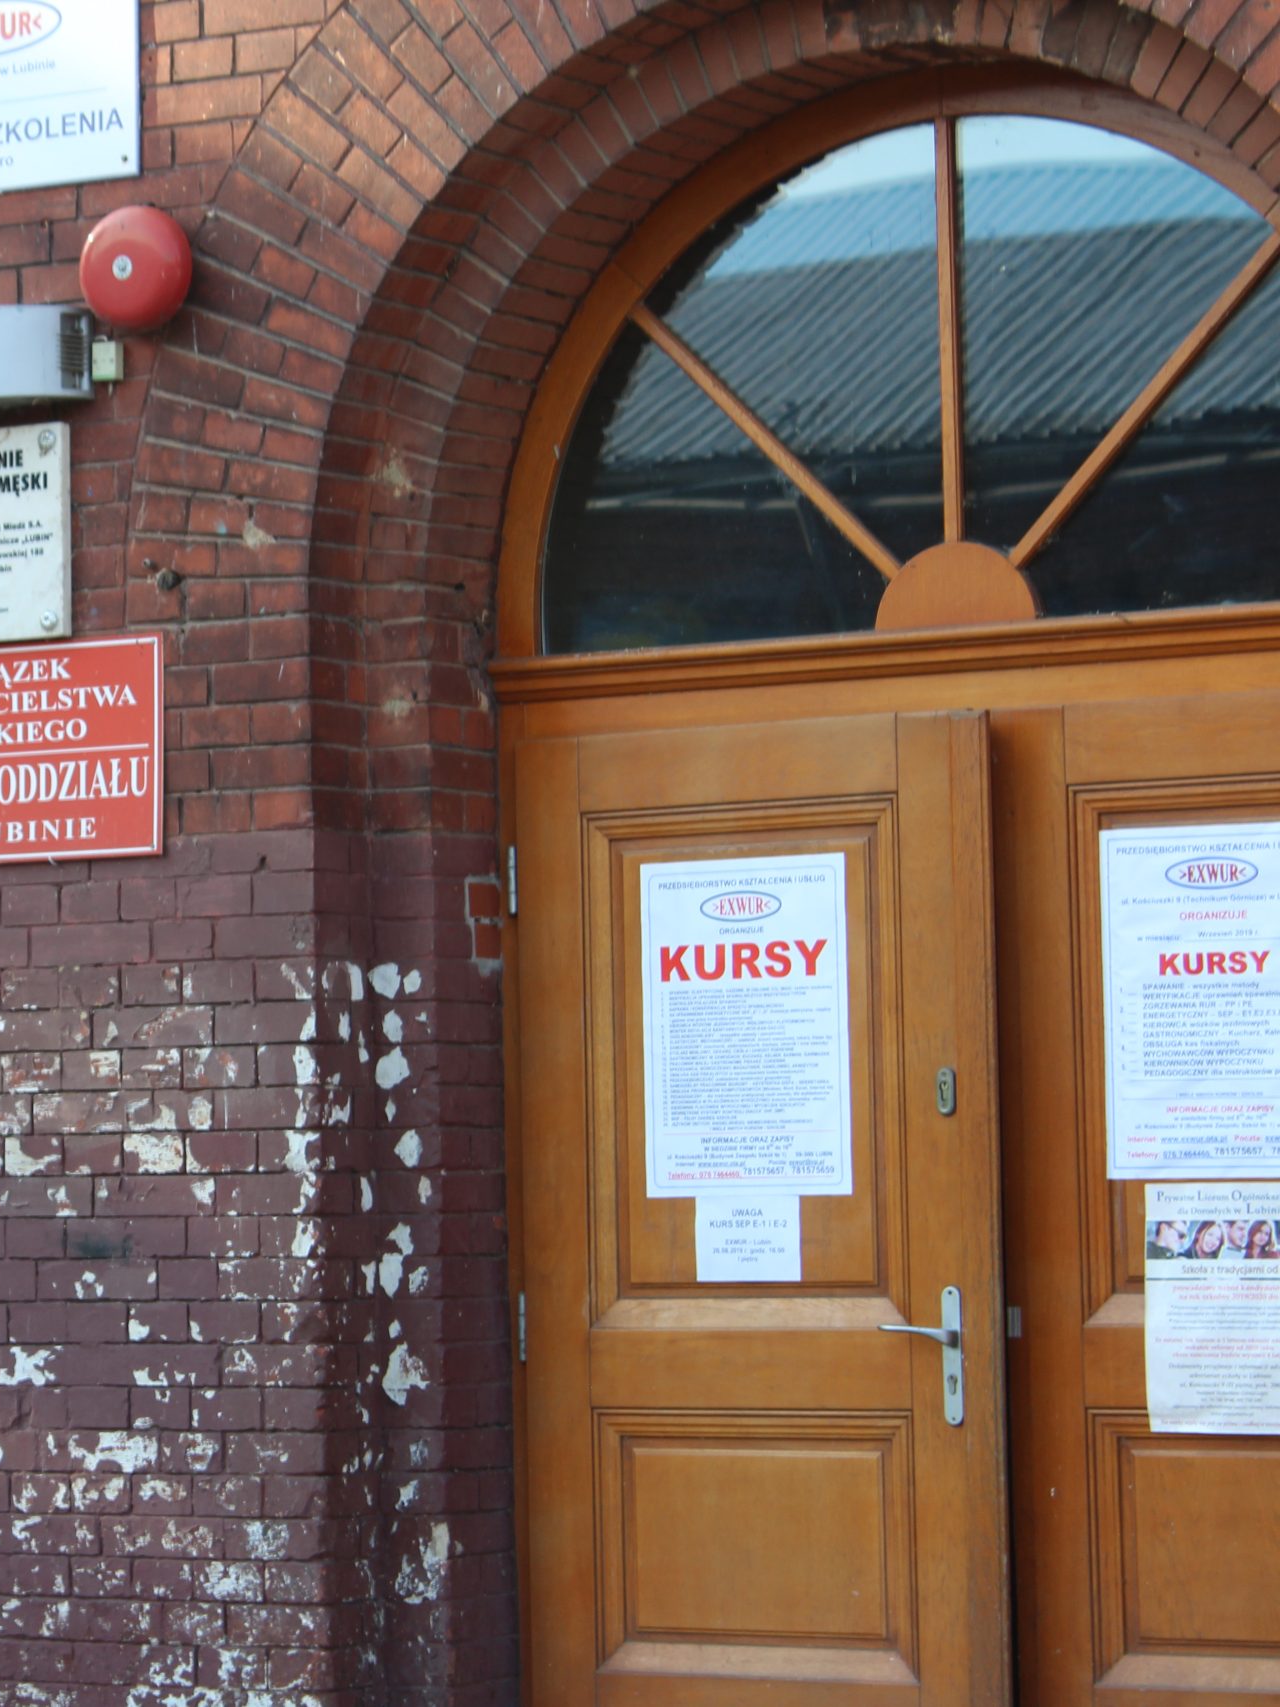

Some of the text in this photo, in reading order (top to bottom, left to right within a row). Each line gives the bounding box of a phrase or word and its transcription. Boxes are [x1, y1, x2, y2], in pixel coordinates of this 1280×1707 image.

[0, 66, 10, 77] w
[12, 58, 56, 74] Lubinie
[1115, 843, 1207, 856] PRZEDSIĘBIORSTWO
[1209, 841, 1270, 853] KSZTAŁCENIA
[738, 876, 792, 887] KSZTAŁCENIA
[798, 874, 826, 882] USŁUG
[1132, 896, 1174, 905] Kościuszki
[1183, 895, 1228, 904] (Technikum
[1179, 909, 1248, 921] ORGANIZUJE
[719, 926, 765, 935] ORGANIZUJE
[659, 939, 828, 982] KURSY
[1158, 951, 1271, 976] KURSY
[1142, 981, 1260, 992] SPAWANIE wszystkie metody
[1142, 992, 1200, 1000] WERYFIKACJE
[1143, 1002, 1197, 1010] ZGRZEWANIA
[1198, 1001, 1216, 1009] RUR
[1225, 1000, 1236, 1008] PP
[1242, 999, 1254, 1007] PE
[1143, 1011, 1209, 1019] ENERGETYCZNY
[1217, 1010, 1233, 1018] SEP
[1143, 1020, 1187, 1028] KIEROWCA
[1142, 1029, 1219, 1038] GASTRONOMICZNY
[1142, 1040, 1183, 1048] OBSŁUGA
[1143, 1047, 1274, 1058] WYCHOWAWCÓW WYPOCZYNKU
[1144, 1057, 1265, 1067] KIEROWNIKÓW WYPOCZYNKU
[1144, 1069, 1209, 1077] PEDAGOGICZNY
[1166, 1105, 1219, 1113] INFORMACJE
[1245, 1103, 1275, 1112] ZAPISY
[700, 1134, 795, 1145] INFORMACJE ORAZ ZAPISY
[1197, 1190, 1230, 1202] Liceum
[731, 1208, 763, 1217] UWAGA
[1190, 1205, 1232, 1217] Dorosłych
[709, 1218, 788, 1229] KURS SEP E-1 E-2
[1182, 1265, 1208, 1275] Szkoła
[1217, 1265, 1265, 1277] tradycjami
[1266, 1265, 1280, 1274] od
